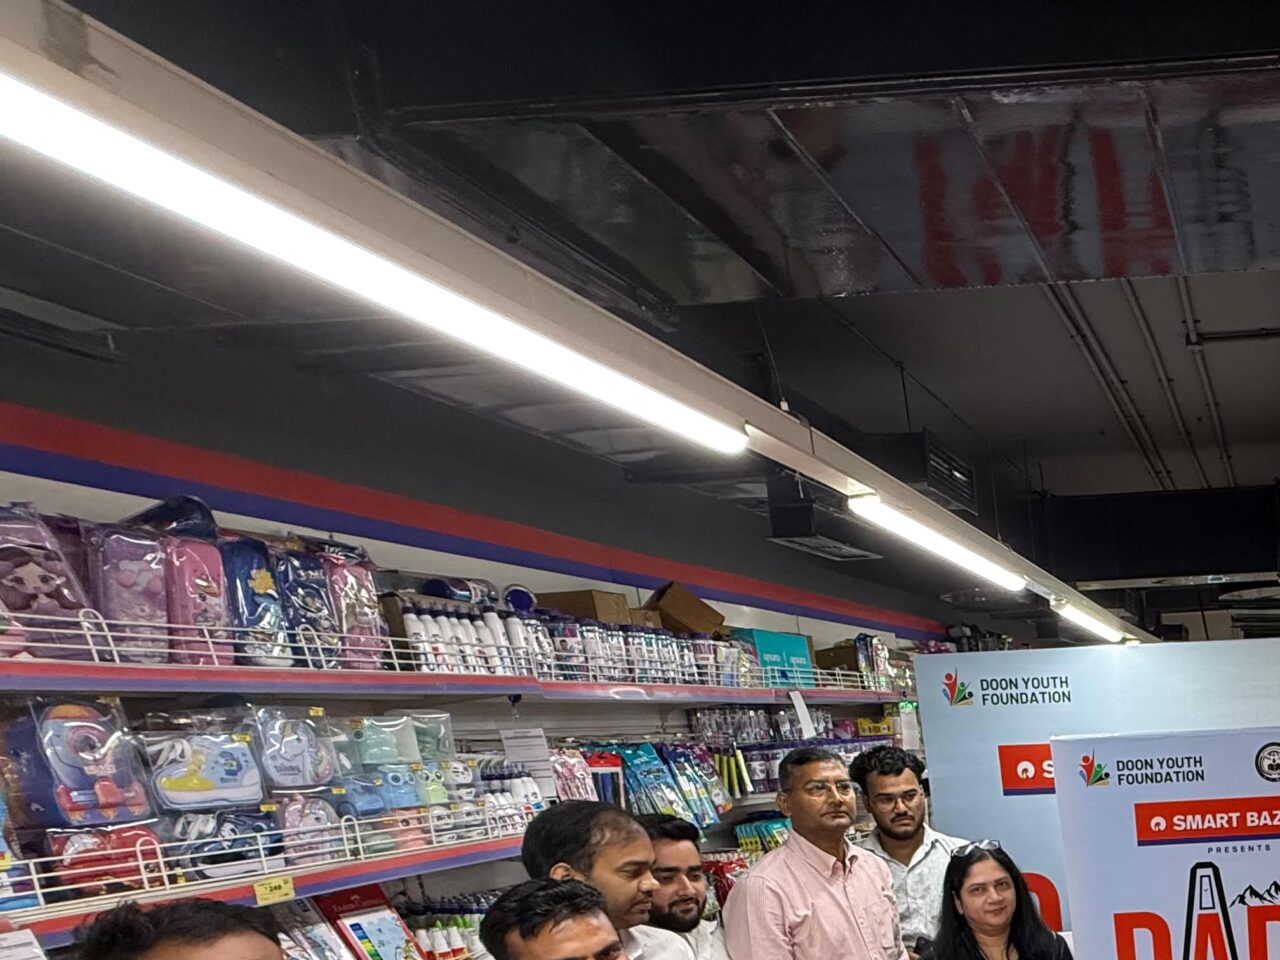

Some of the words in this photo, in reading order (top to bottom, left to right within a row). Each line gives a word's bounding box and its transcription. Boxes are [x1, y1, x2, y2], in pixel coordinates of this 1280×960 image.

[980, 677, 1019, 691] DOON
[1022, 676, 1069, 689] YOUTH
[982, 690, 1071, 706] FOUNDATION
[1116, 758, 1153, 772] DOON
[1157, 756, 1203, 769] YOUTH
[1117, 770, 1205, 785] FOUNDATION
[1173, 813, 1240, 831] SMART
[1207, 845, 1272, 854] PRESENTS
